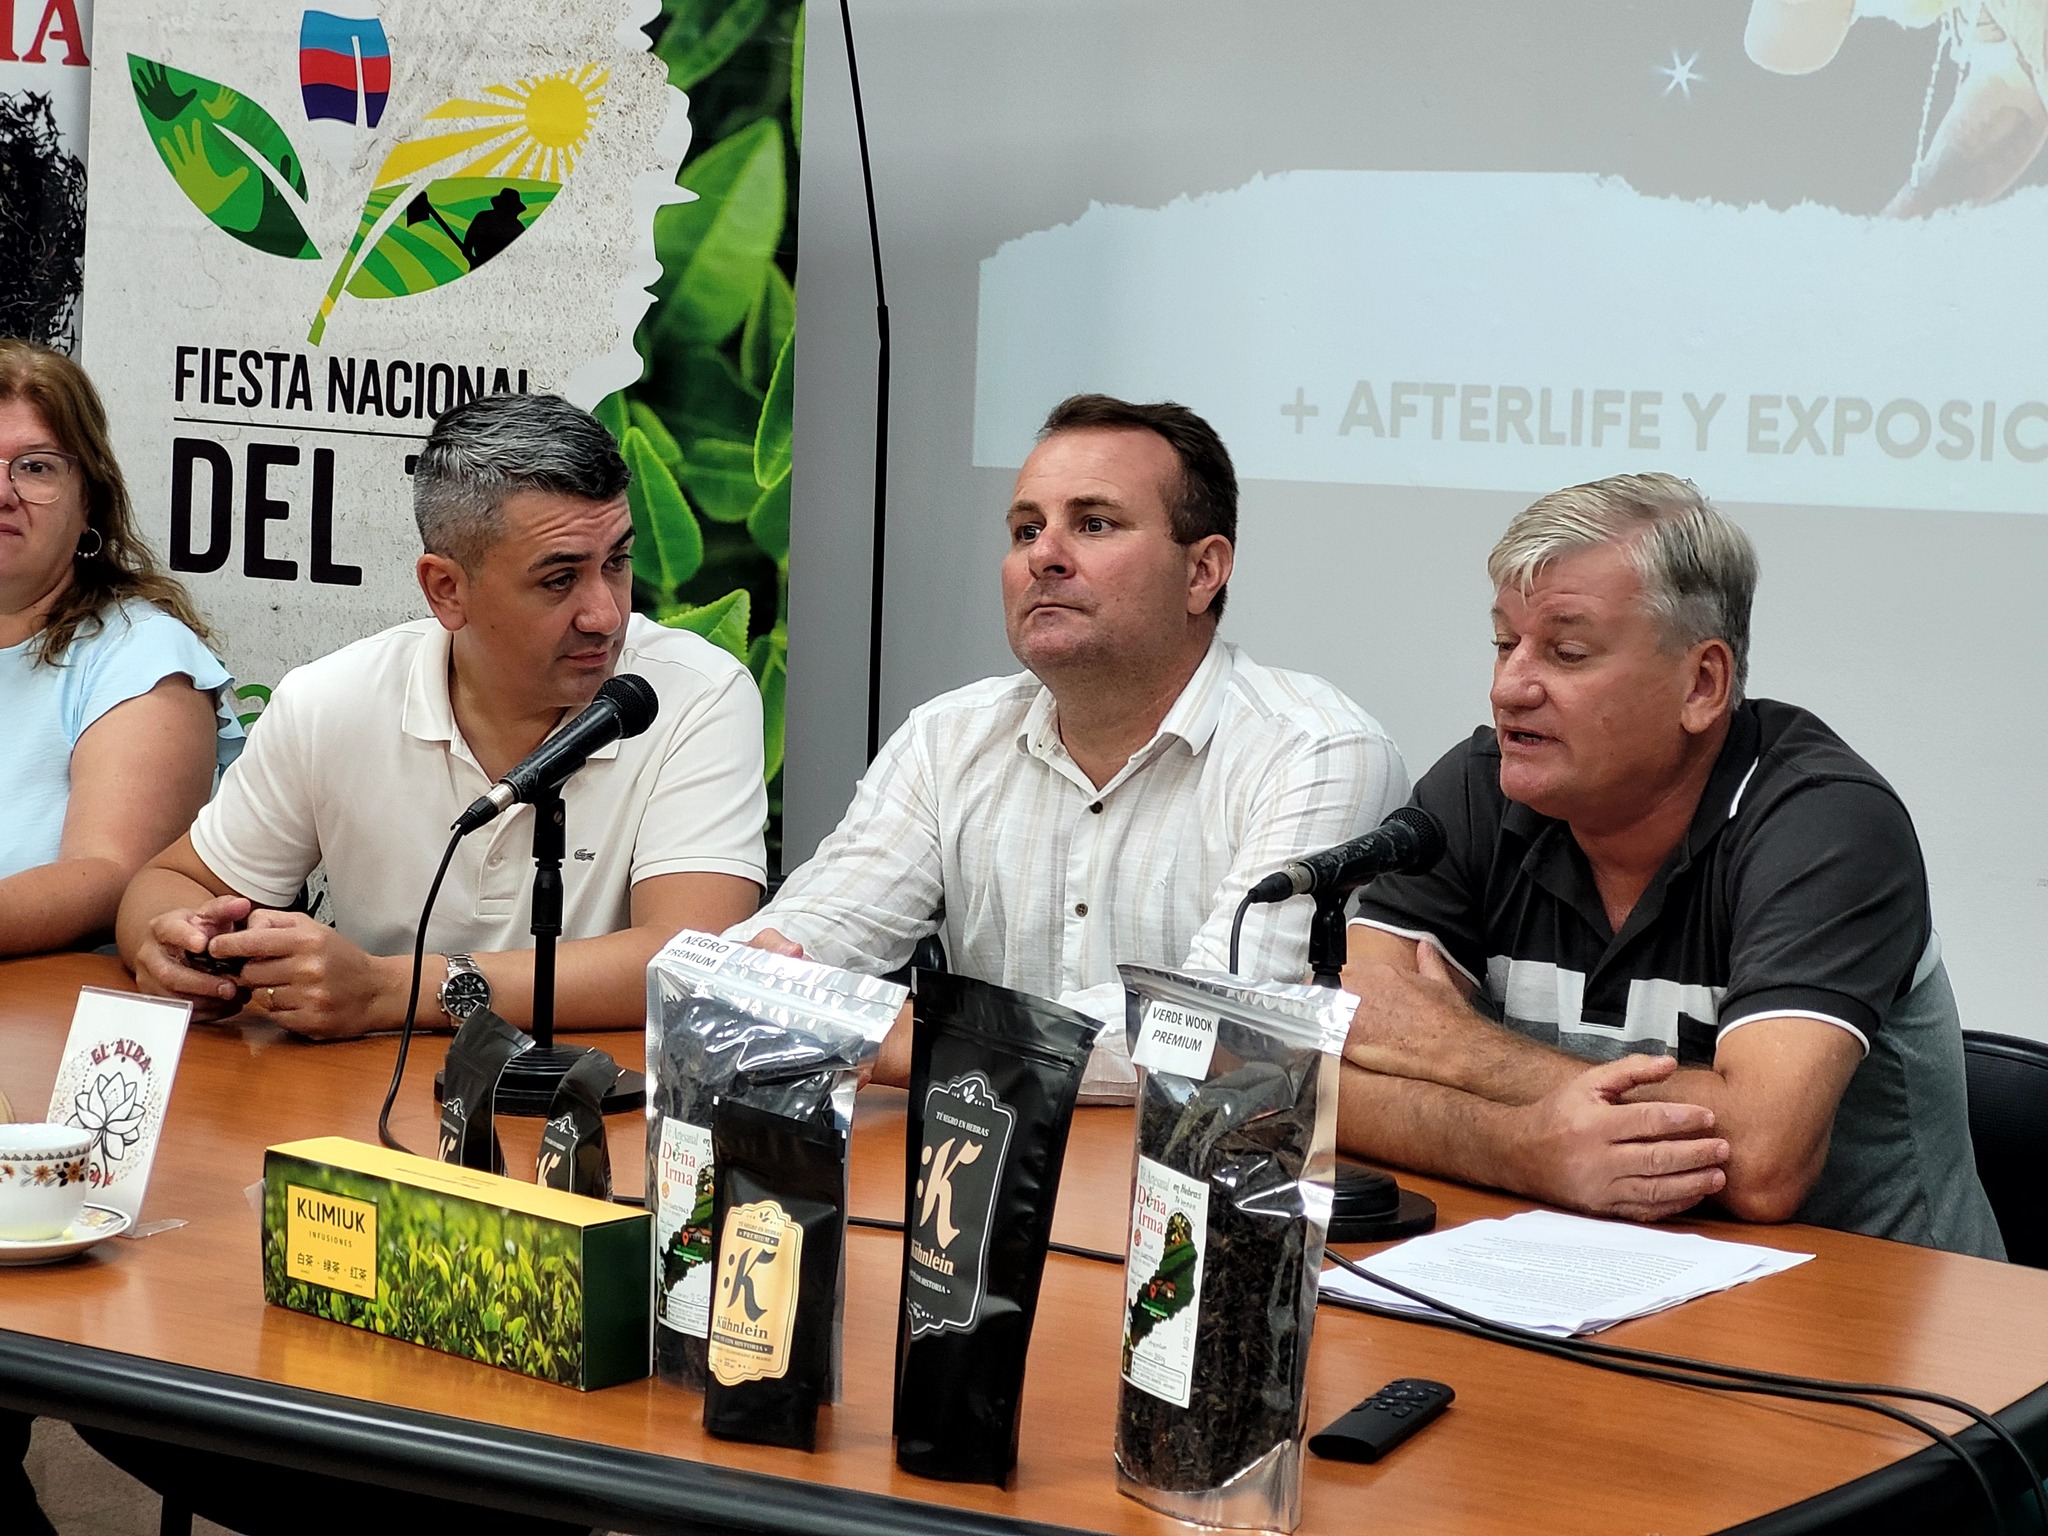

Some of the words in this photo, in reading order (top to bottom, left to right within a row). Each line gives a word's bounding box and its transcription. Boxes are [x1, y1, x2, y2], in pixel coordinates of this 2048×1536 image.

[175, 345, 313, 411] FIESTA
[1338, 379, 1663, 450] AFTERLIFE
[1681, 391, 1727, 452] Y
[1747, 393, 2048, 464] EXPOSIC
[169, 437, 363, 586] DEL
[681, 936, 730, 953] NEGRO
[665, 948, 717, 968] PREMIUM
[1152, 1006, 1183, 1026] VERDE
[1185, 1013, 1213, 1033] WOOK
[1151, 1029, 1202, 1052] PREMIUM
[665, 1161, 693, 1186] Irma
[297, 1196, 366, 1234] KLIMIUK
[1137, 1206, 1164, 1235] Irma
[309, 1230, 353, 1248] INFUSIONES
[743, 1231, 771, 1244] PREMIUM
[716, 1315, 768, 1339] Kühnlein
